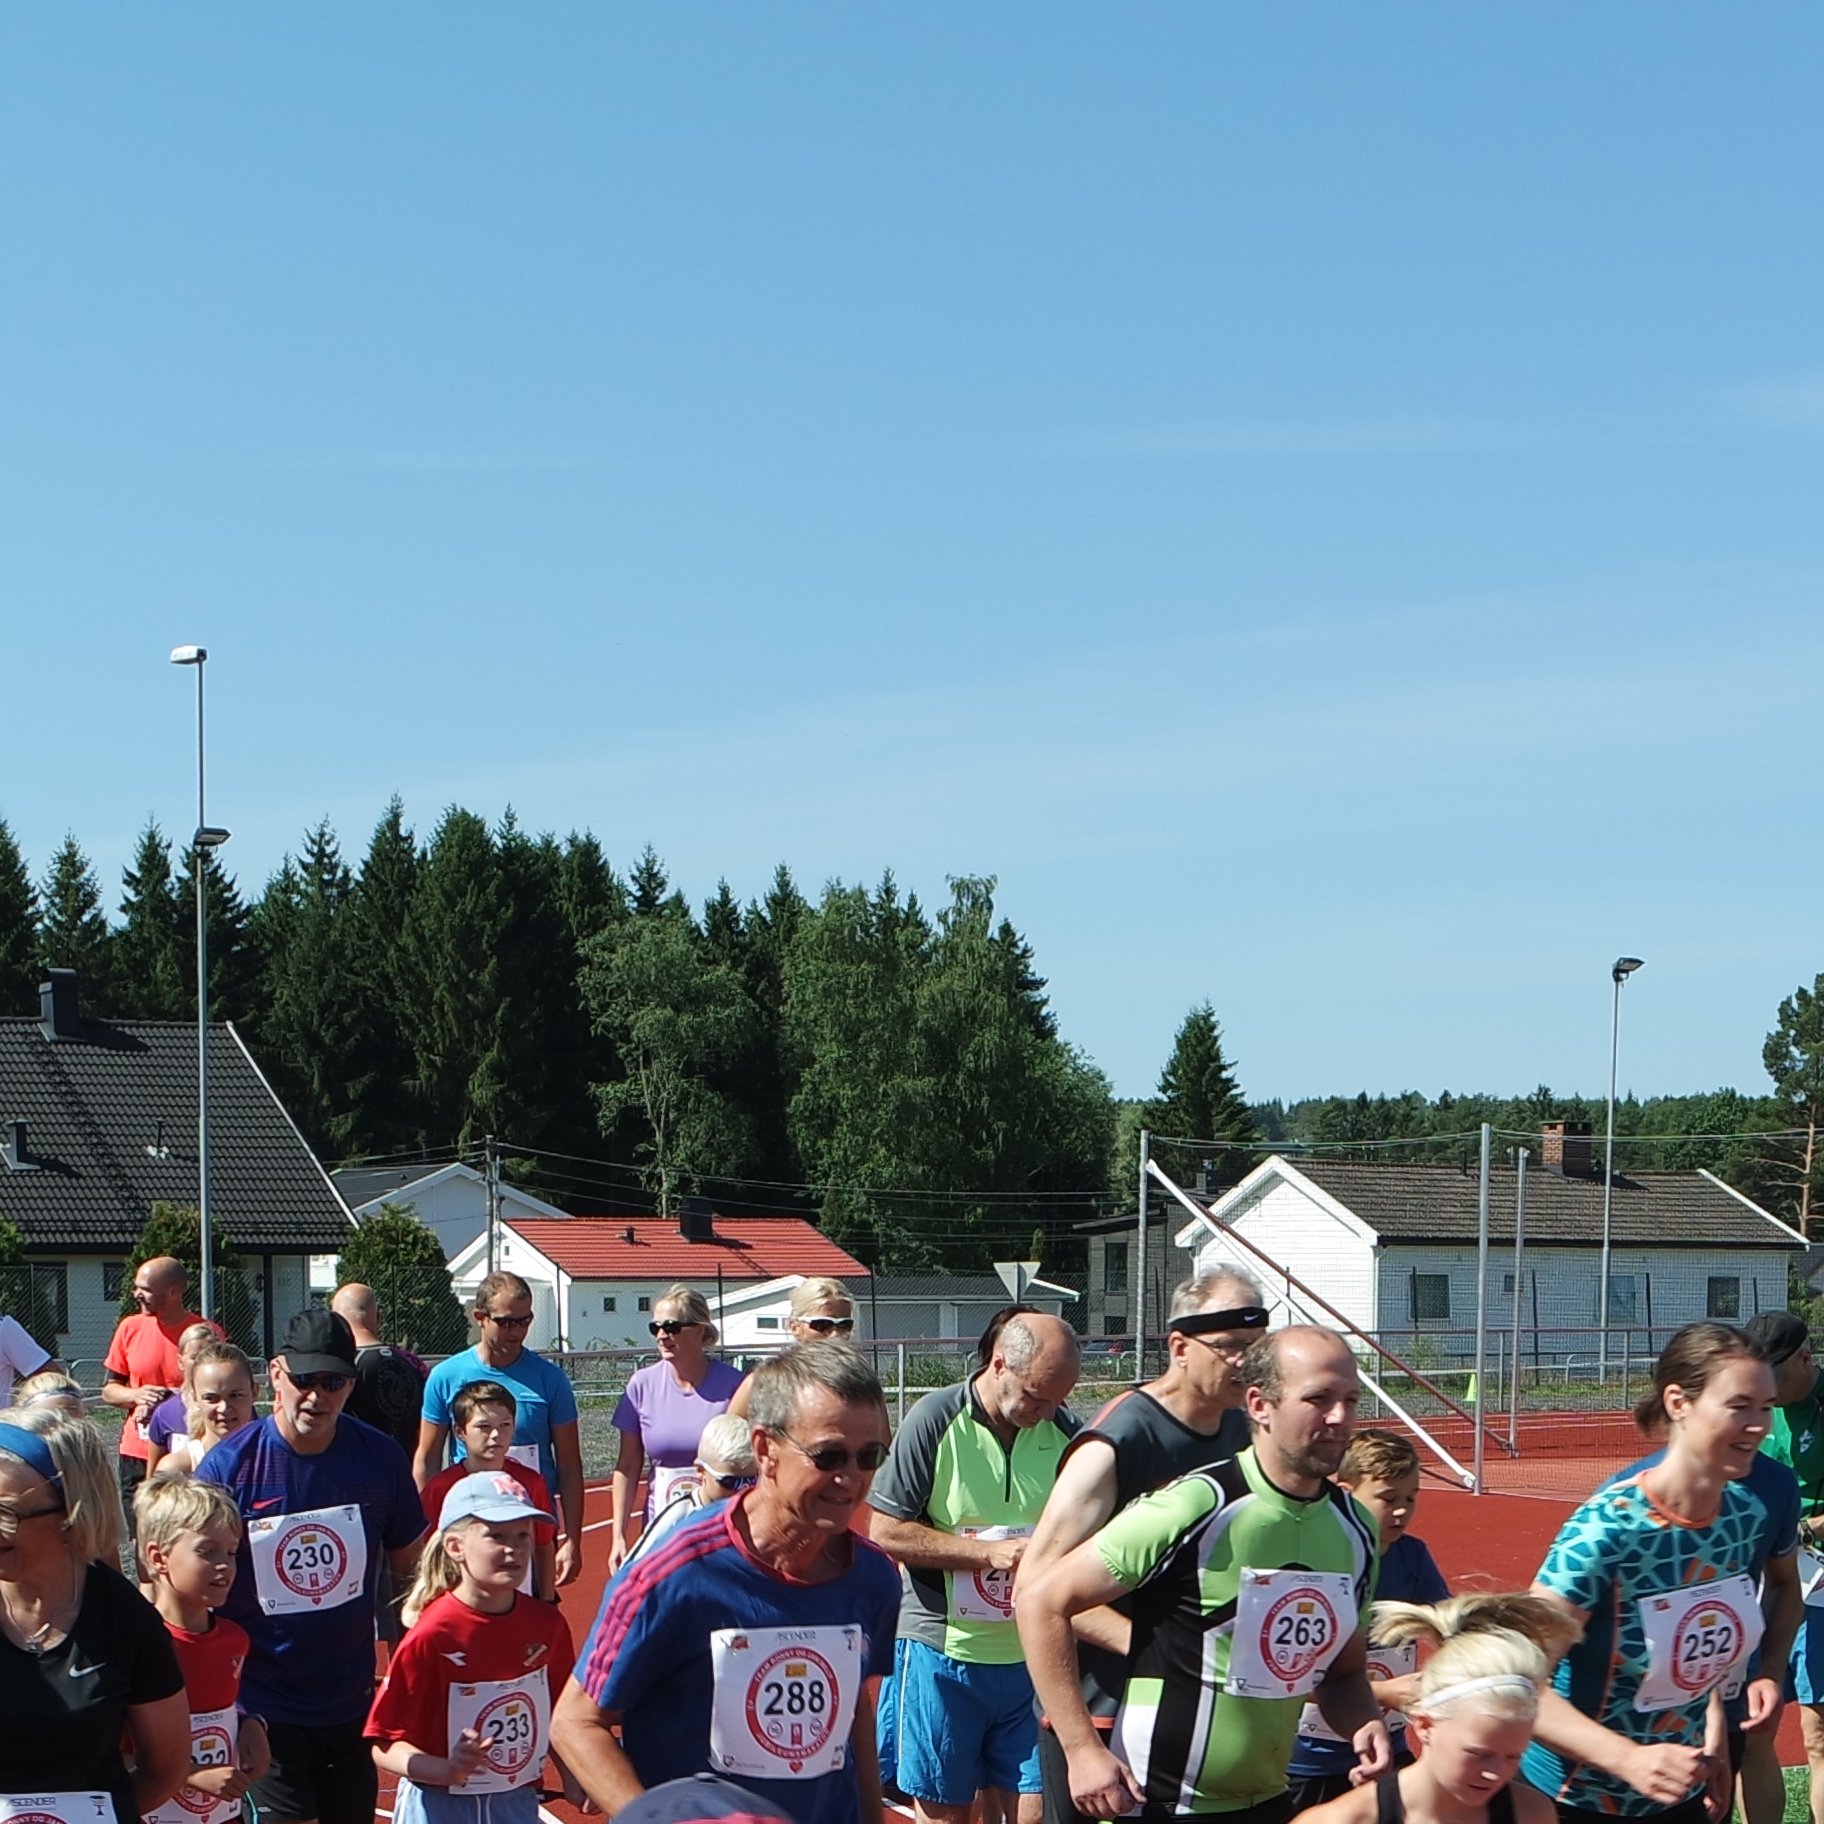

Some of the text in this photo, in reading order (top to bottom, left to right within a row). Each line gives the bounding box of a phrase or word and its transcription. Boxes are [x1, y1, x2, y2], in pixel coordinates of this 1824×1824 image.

[287, 1543, 334, 1570] 230
[1274, 1616, 1326, 1646] 263
[1683, 1626, 1733, 1664] 252
[764, 1681, 825, 1715] 288
[487, 1713, 530, 1745] 233
[6, 1796, 56, 1807] ASCENDER
[32, 1815, 45, 1823] OG
